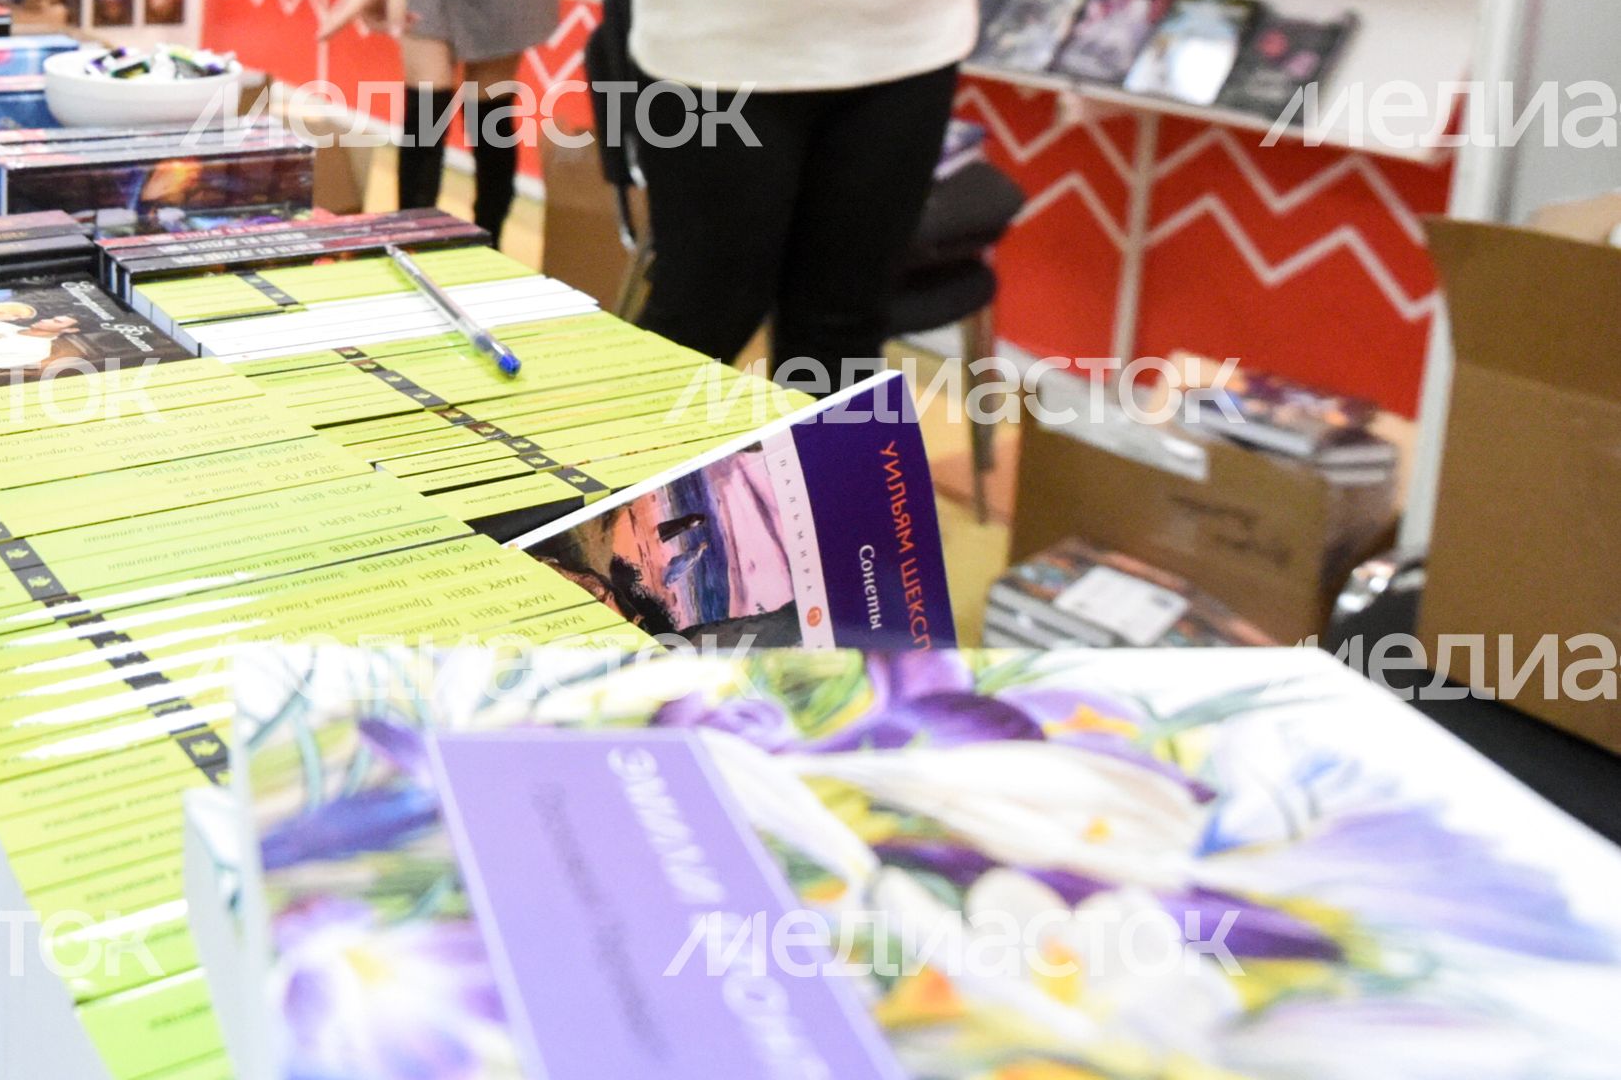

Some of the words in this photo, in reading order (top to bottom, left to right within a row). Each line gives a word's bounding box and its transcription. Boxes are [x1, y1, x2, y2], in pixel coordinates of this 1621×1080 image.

[879, 440, 915, 554] УИЛЬЯМ
[400, 525, 441, 541] ИВАН
[779, 458, 813, 593] ПАЛЬМИРА
[328, 535, 395, 554] ТУРГЕНЕВ
[429, 543, 470, 558] ИВАН
[358, 551, 426, 574] ТУРГЕНЕВ
[460, 557, 501, 572] МАРК
[417, 567, 456, 582] ТВЕН
[485, 575, 527, 590] МАРК
[443, 585, 482, 600] ТВЕН
[858, 544, 882, 631] Сонеты
[515, 593, 556, 610] МАРК
[469, 603, 510, 619] ТВЕН
